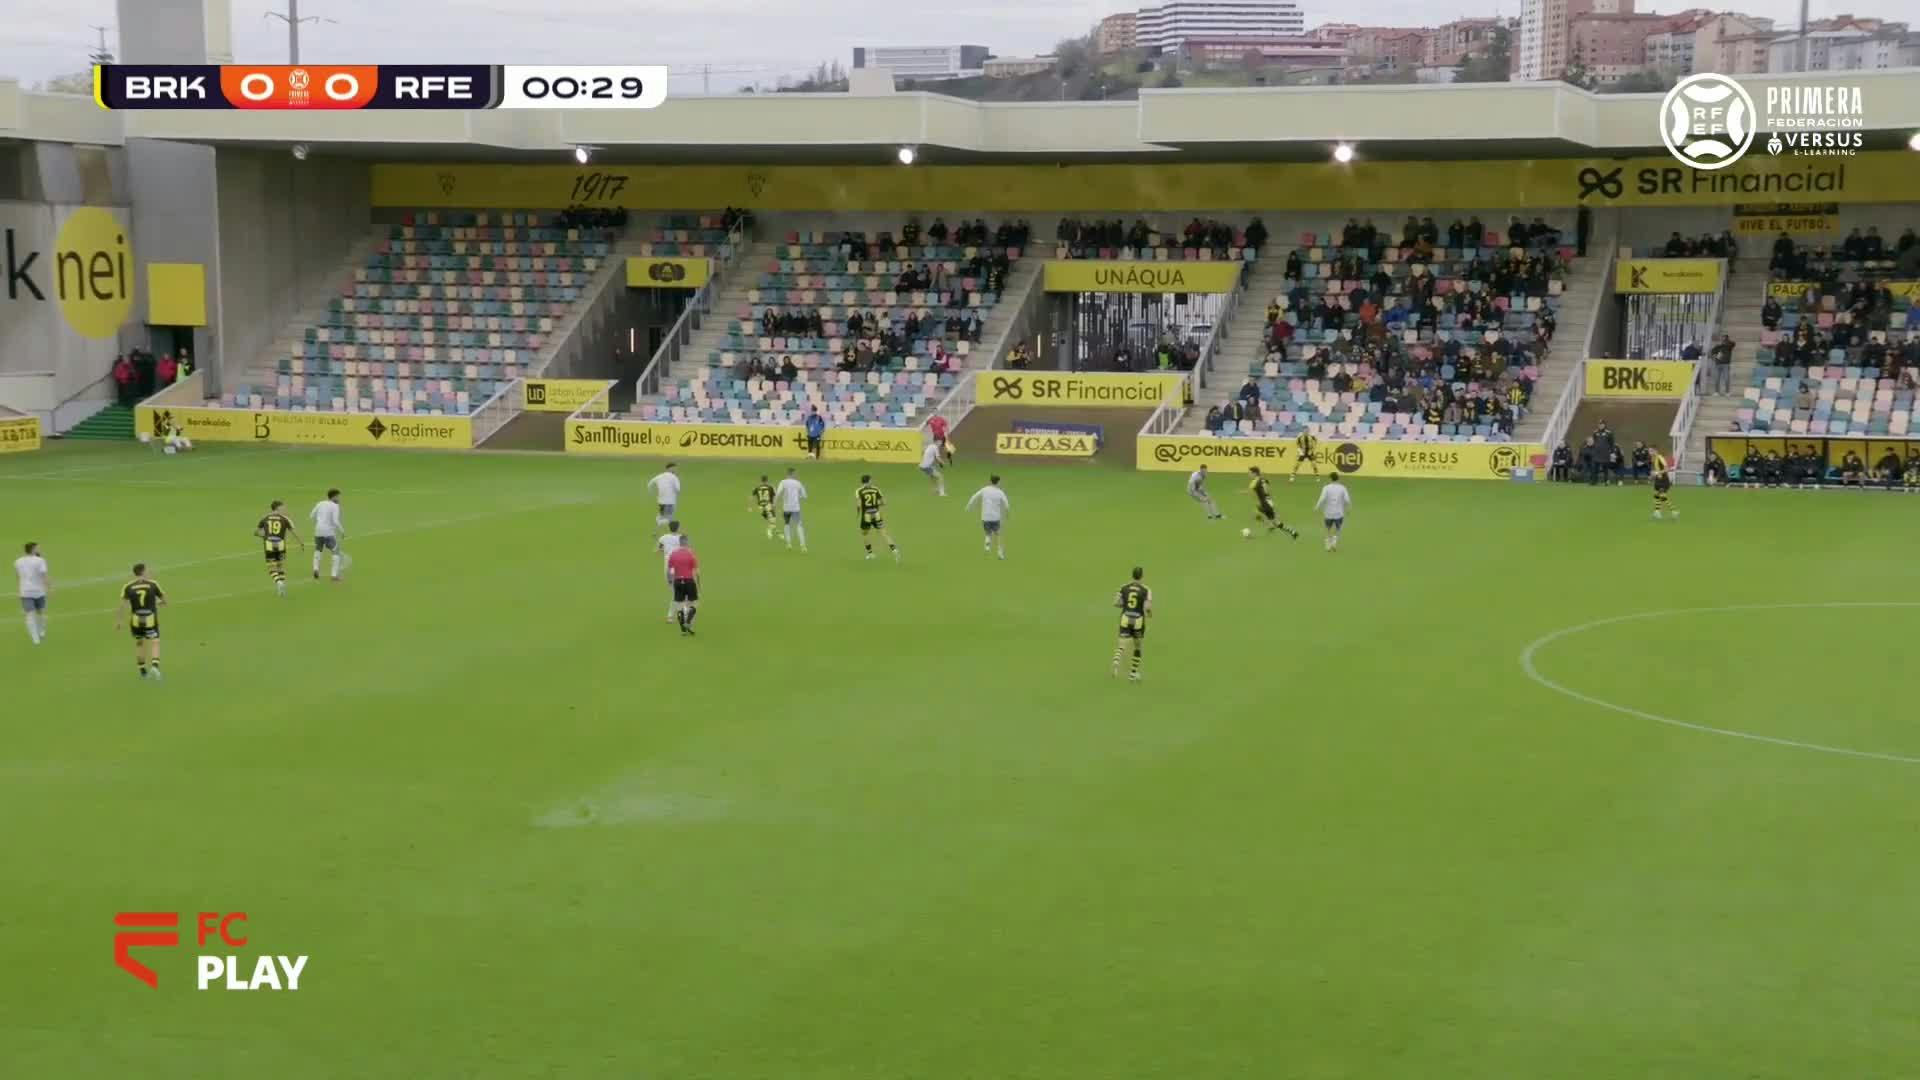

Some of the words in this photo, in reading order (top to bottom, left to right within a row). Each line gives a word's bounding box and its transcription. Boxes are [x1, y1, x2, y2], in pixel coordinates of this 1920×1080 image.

[571, 173, 629, 201] 1917
[1638, 167, 1683, 195] SR
[1692, 163, 1845, 193] Financial
[1095, 266, 1185, 288] UNÁQUA
[1603, 366, 1647, 390] BRK
[1032, 380, 1061, 398] SR
[1066, 380, 1163, 401] Financial
[390, 423, 455, 439] Radimer
[700, 433, 783, 447] DECATHLON
[999, 437, 1090, 452] JICASA
[1179, 444, 1252, 457] COCINAS
[1254, 446, 1286, 458] REY
[1399, 451, 1459, 464] VERSUS
[864, 495, 877, 506] 21
[268, 520, 281, 534] 19
[137, 590, 146, 607] 7
[1127, 592, 1137, 608] 5
